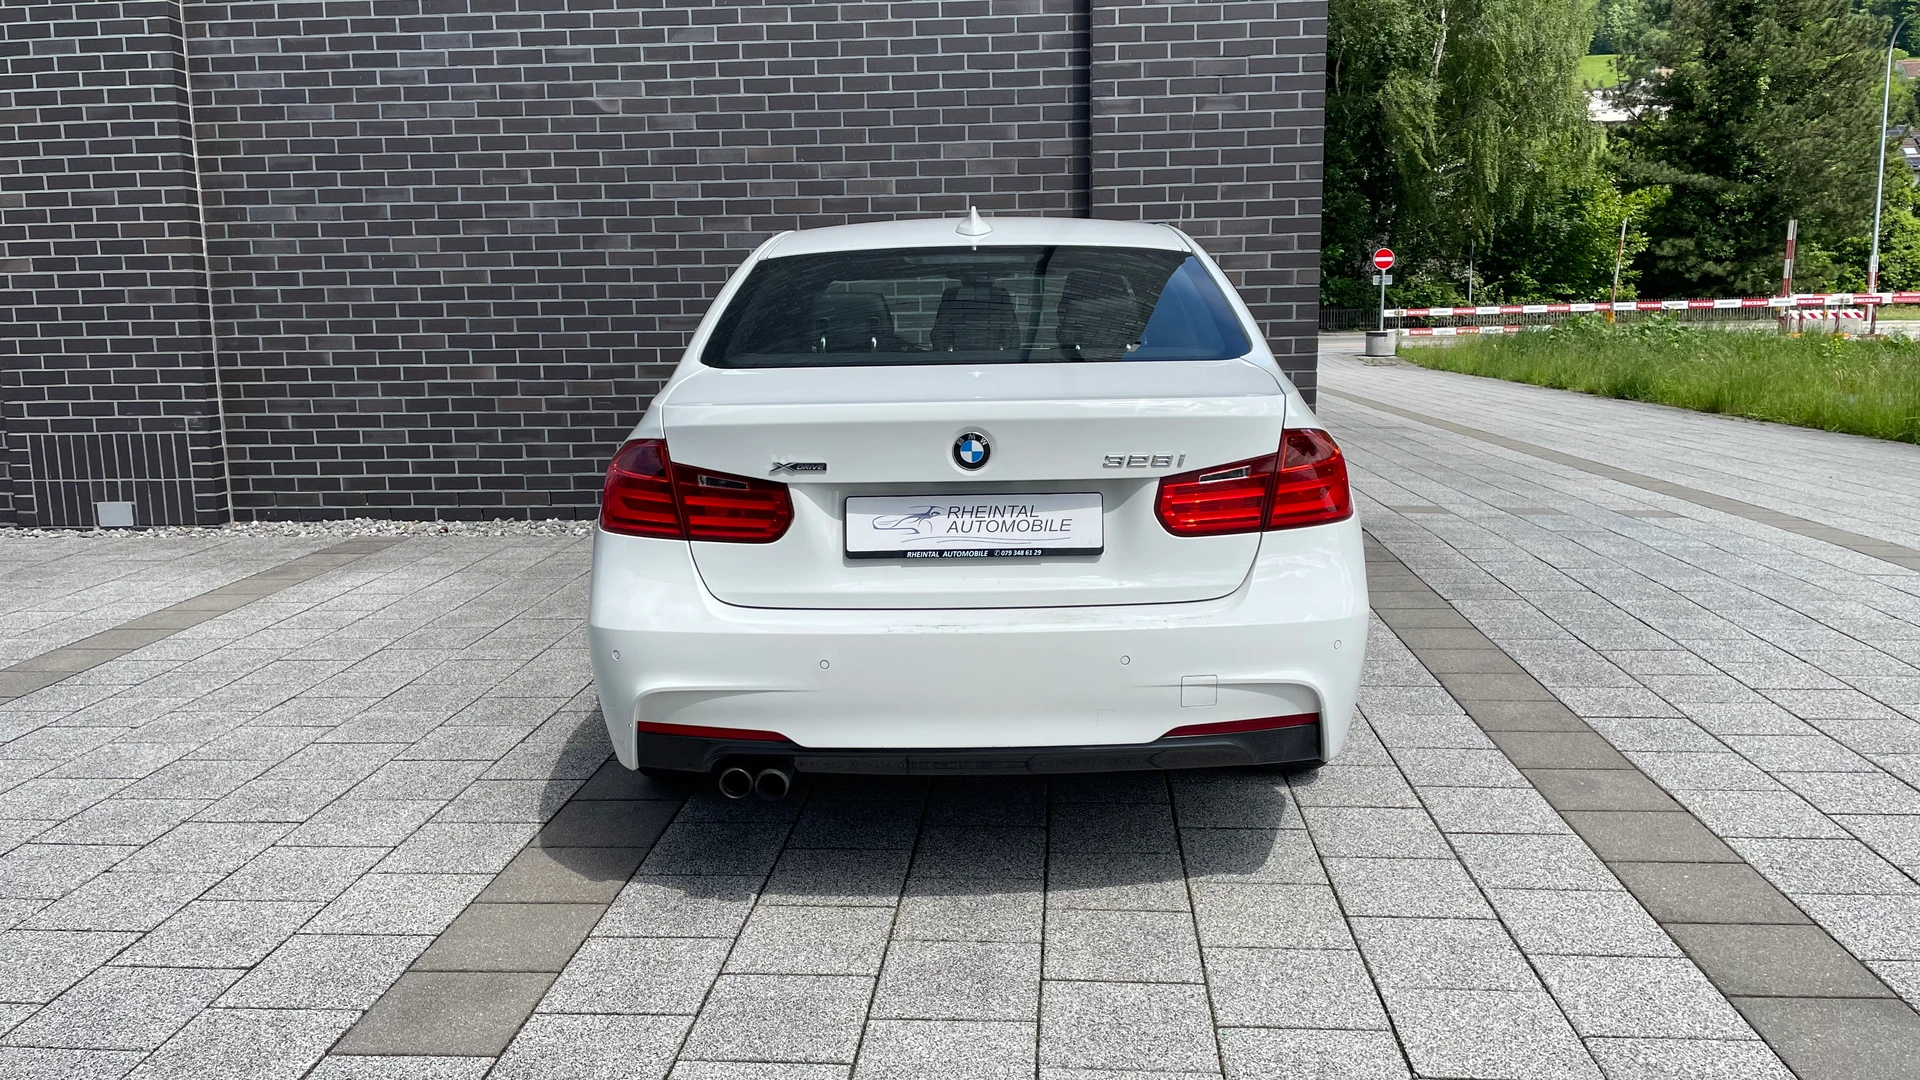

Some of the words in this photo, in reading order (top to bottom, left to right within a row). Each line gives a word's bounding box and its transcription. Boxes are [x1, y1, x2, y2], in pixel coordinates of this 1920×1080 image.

[956, 433, 988, 446] BMW
[1102, 450, 1186, 469] 328i
[946, 504, 1040, 519] RHEINTAL
[946, 518, 1073, 534] AUTOMOBILE
[906, 550, 940, 558] RHEINTAL
[942, 550, 988, 558] AUTOMOBILE
